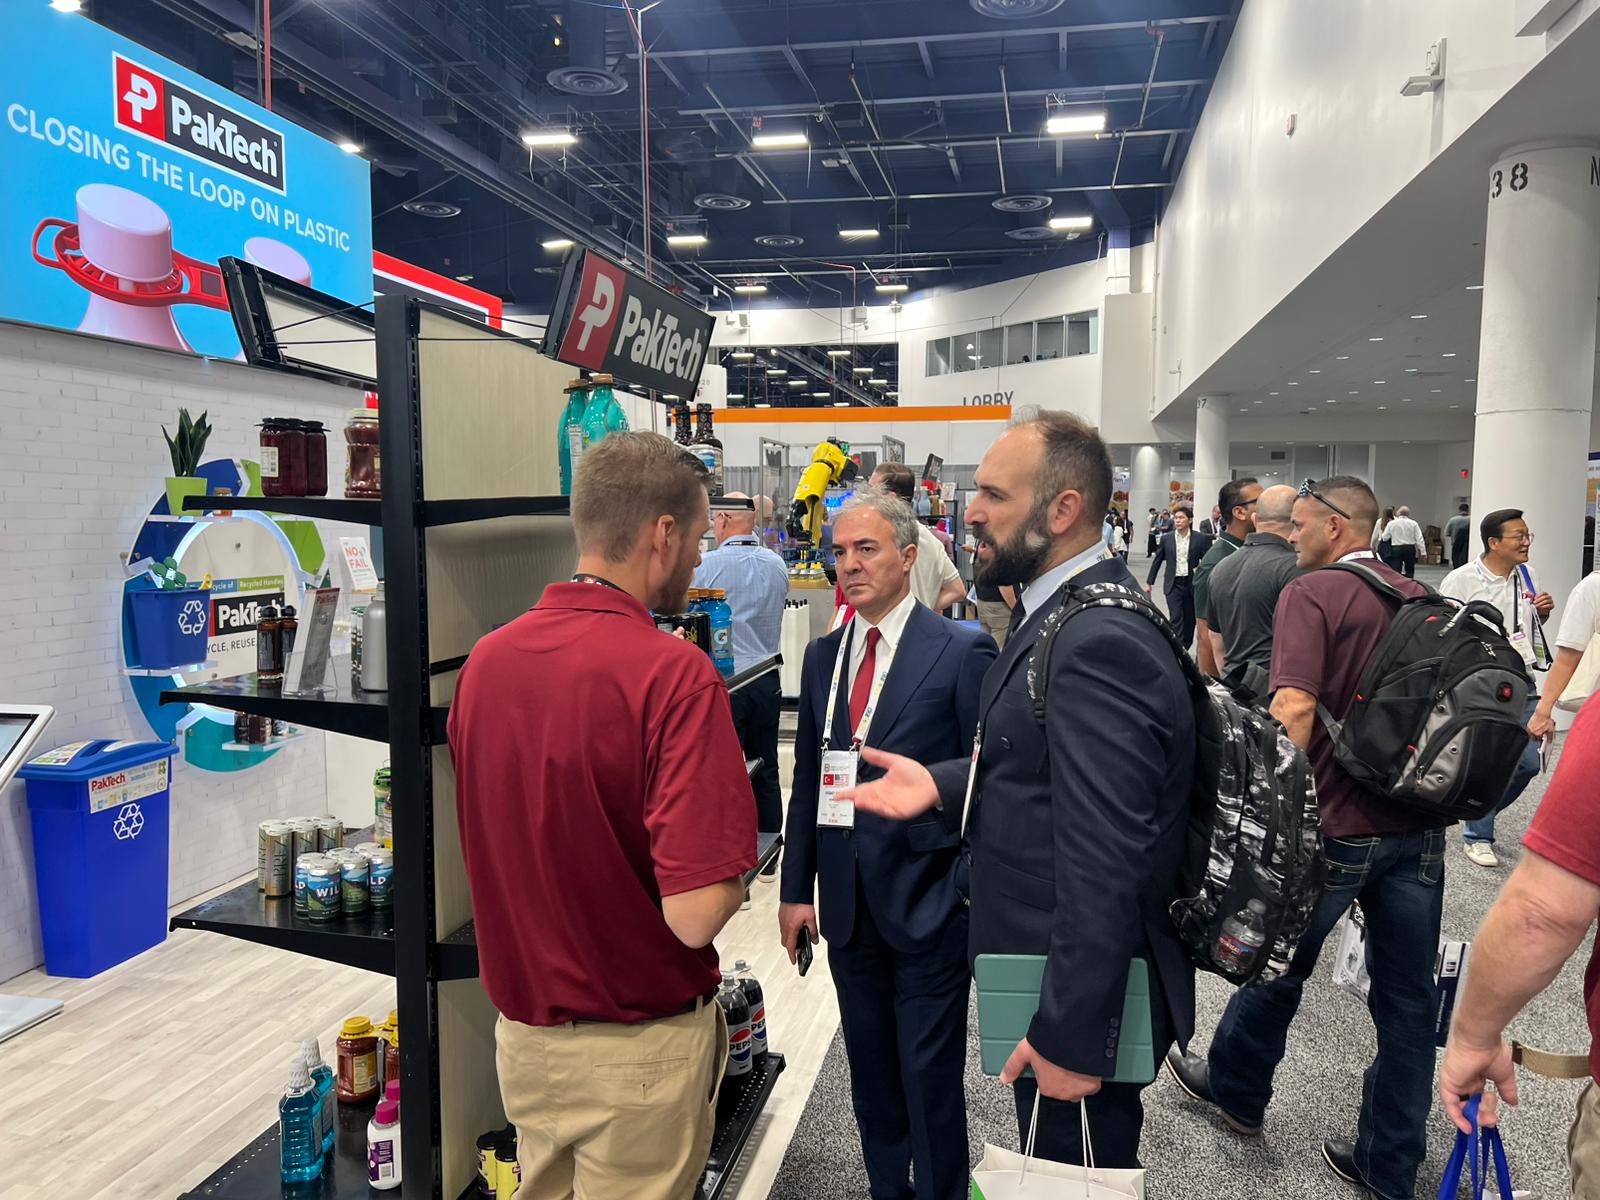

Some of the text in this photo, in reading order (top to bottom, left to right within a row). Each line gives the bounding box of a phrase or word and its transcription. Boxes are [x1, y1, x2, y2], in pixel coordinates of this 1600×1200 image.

[171, 95, 278, 177] PakTech
[7, 104, 350, 252] CLOSING THE LOOP ON PLASTIC
[1491, 162, 1528, 199] 38
[613, 295, 703, 382] PakTech
[218, 599, 281, 629] PakTeh
[91, 773, 126, 792] PakTech
